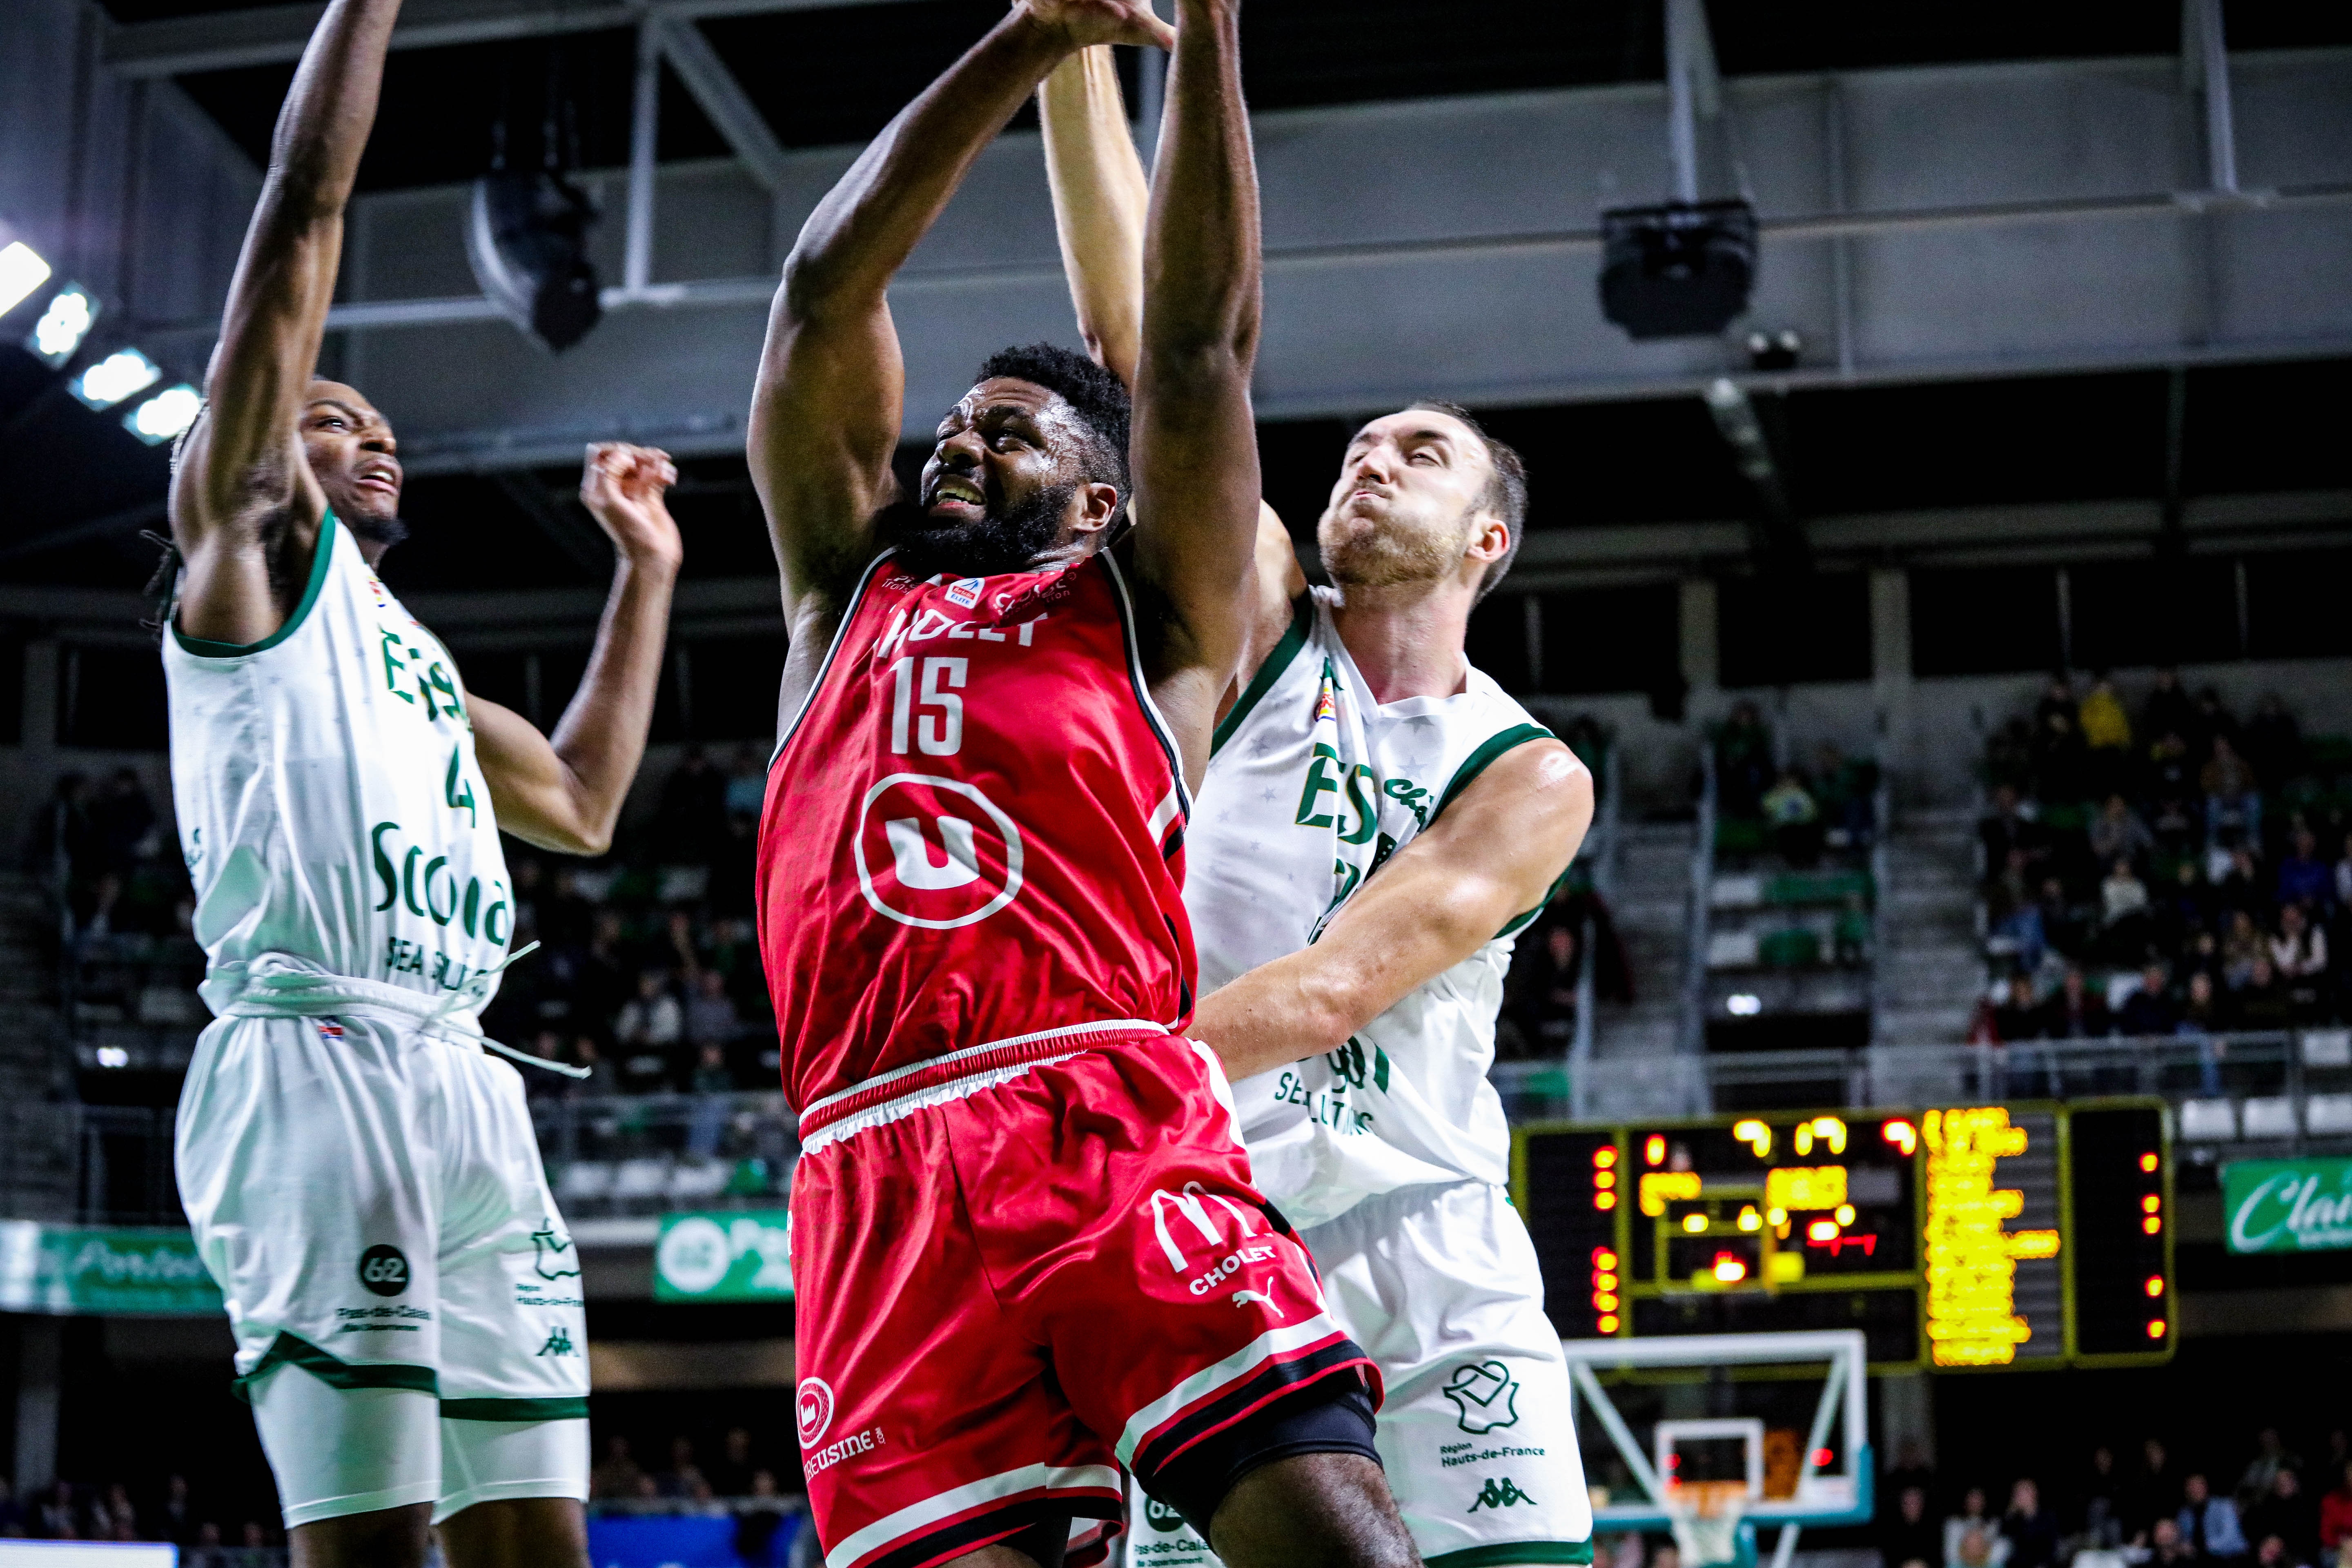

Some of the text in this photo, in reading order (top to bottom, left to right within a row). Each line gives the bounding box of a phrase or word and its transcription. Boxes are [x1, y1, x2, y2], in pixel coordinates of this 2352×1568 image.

[889, 657, 969, 756] 15
[445, 740, 476, 828] 4
[364, 1257, 407, 1282] 62
[1189, 1245, 1276, 1296] CHOLET
[1439, 1441, 1472, 1455] Région
[1441, 1446, 1546, 1468] Hauts-de-France
